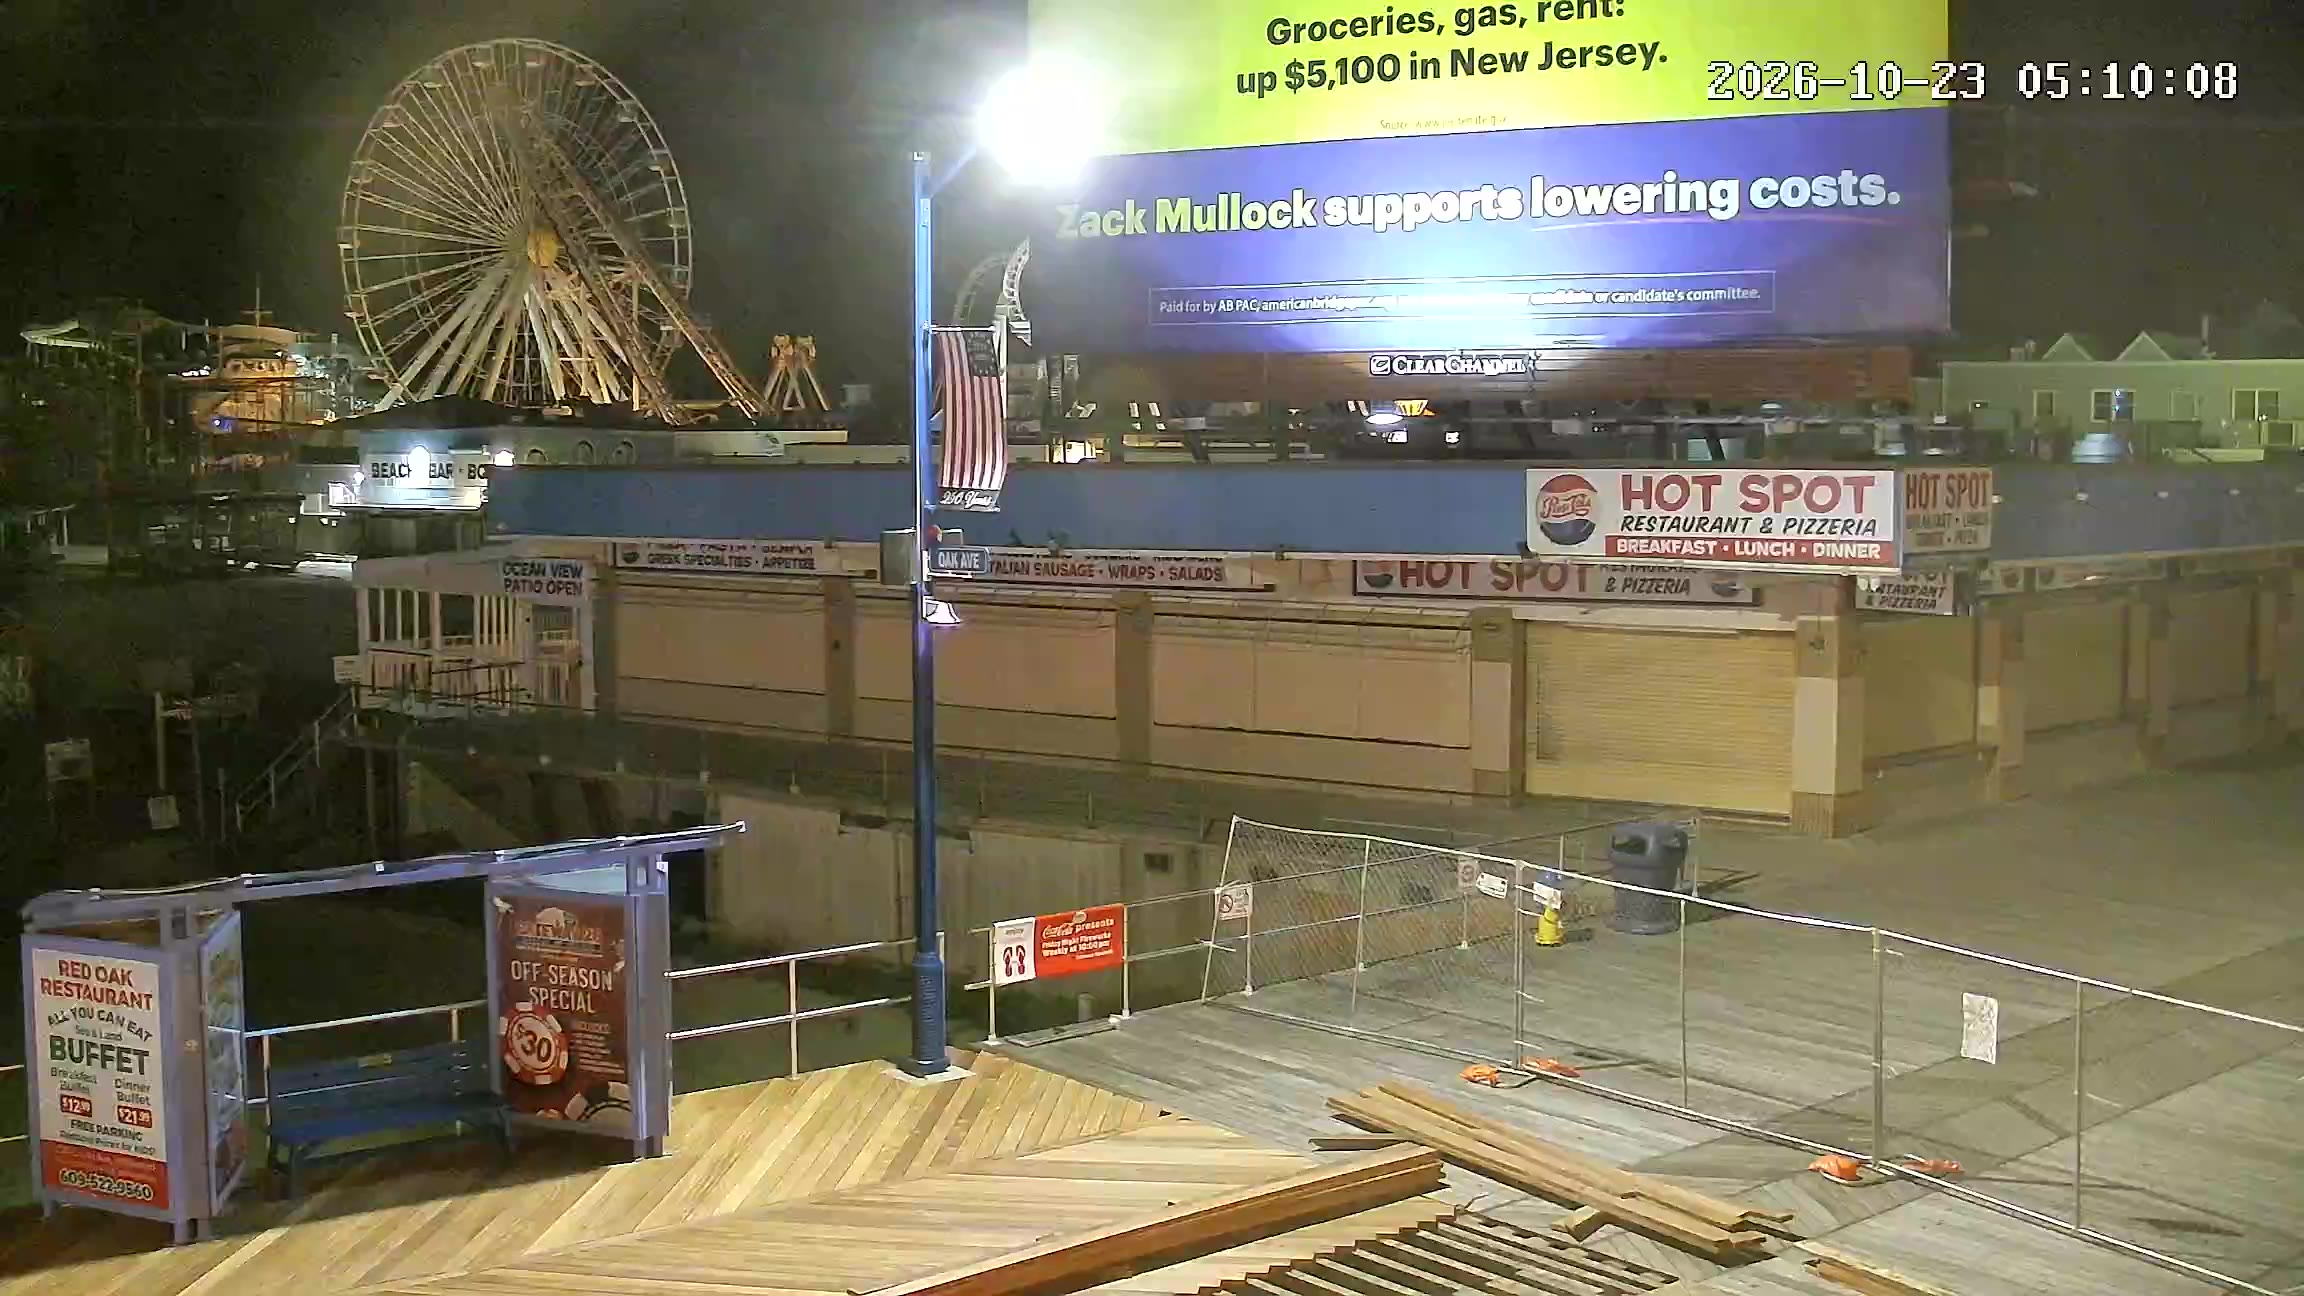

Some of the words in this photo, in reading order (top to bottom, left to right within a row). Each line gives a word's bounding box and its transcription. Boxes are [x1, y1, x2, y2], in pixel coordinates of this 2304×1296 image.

[1267, 6, 1444, 45] Groceries,
[1454, 3, 1527, 36] gas,
[1538, 0, 1624, 22] rent:
[1237, 70, 1277, 98] up
[1285, 53, 1400, 93] $5,100
[1410, 50, 1440, 80] in
[1450, 48, 1528, 77] New
[1538, 40, 1667, 71] Jersey.
[1056, 200, 1147, 239] Zack
[1155, 188, 1317, 233] Mullock
[1322, 183, 1524, 233] supports
[1530, 169, 1740, 221] lowering
[1748, 169, 1900, 209] costs.
[1160, 301, 1183, 313] Paid
[1185, 300, 1201, 312] for
[1202, 301, 1217, 315] by
[1217, 299, 1234, 312] AB
[1235, 298, 1260, 313] PAC,
[1610, 288, 1684, 303] candidate's
[1686, 286, 1760, 301] committee.
[1620, 474, 1722, 513] HOT
[1739, 474, 1876, 514] SPOT
[1906, 472, 1940, 510] HOT
[1945, 471, 1991, 509] SPOT
[1620, 516, 1753, 534] RESTAURANT
[1760, 517, 1773, 534] &
[1782, 518, 1877, 536] PIZZERIA
[938, 551, 959, 569] OAK
[960, 551, 980, 569] AVE
[1617, 539, 1717, 557] BREAKFAST
[1734, 540, 1795, 558] LUNCH
[1813, 542, 1881, 560] DINNER
[503, 561, 546, 576] OCEAN
[550, 562, 583, 578] VIEW
[989, 560, 1030, 576] TALIAN
[1034, 561, 1095, 578] SAUSAGE
[1108, 563, 1154, 580] WRAPS
[1169, 566, 1224, 582] SALADS
[1402, 560, 1475, 589] HOT
[1490, 561, 1593, 593] SPOT
[504, 578, 543, 593] PATIO
[546, 580, 583, 596] OPEN
[1605, 577, 1617, 593] &
[1622, 577, 1691, 596] PIZZERIA
[1075, 919, 1114, 932] presents
[58, 959, 92, 980] RED
[95, 966, 133, 988] OAK
[40, 977, 153, 1011] RESTAURANT
[529, 986, 597, 1014] SPECIAL
[48, 1010, 70, 1026] ALL
[70, 1007, 94, 1020] YOU
[97, 1009, 125, 1027] CAN
[127, 1020, 153, 1043] EAT
[50, 1036, 150, 1076] BUFFET
[114, 1078, 151, 1093] Dinner
[116, 1091, 151, 1106] Buffet
[71, 1119, 95, 1133] FREE
[96, 1124, 144, 1142] PARKING
